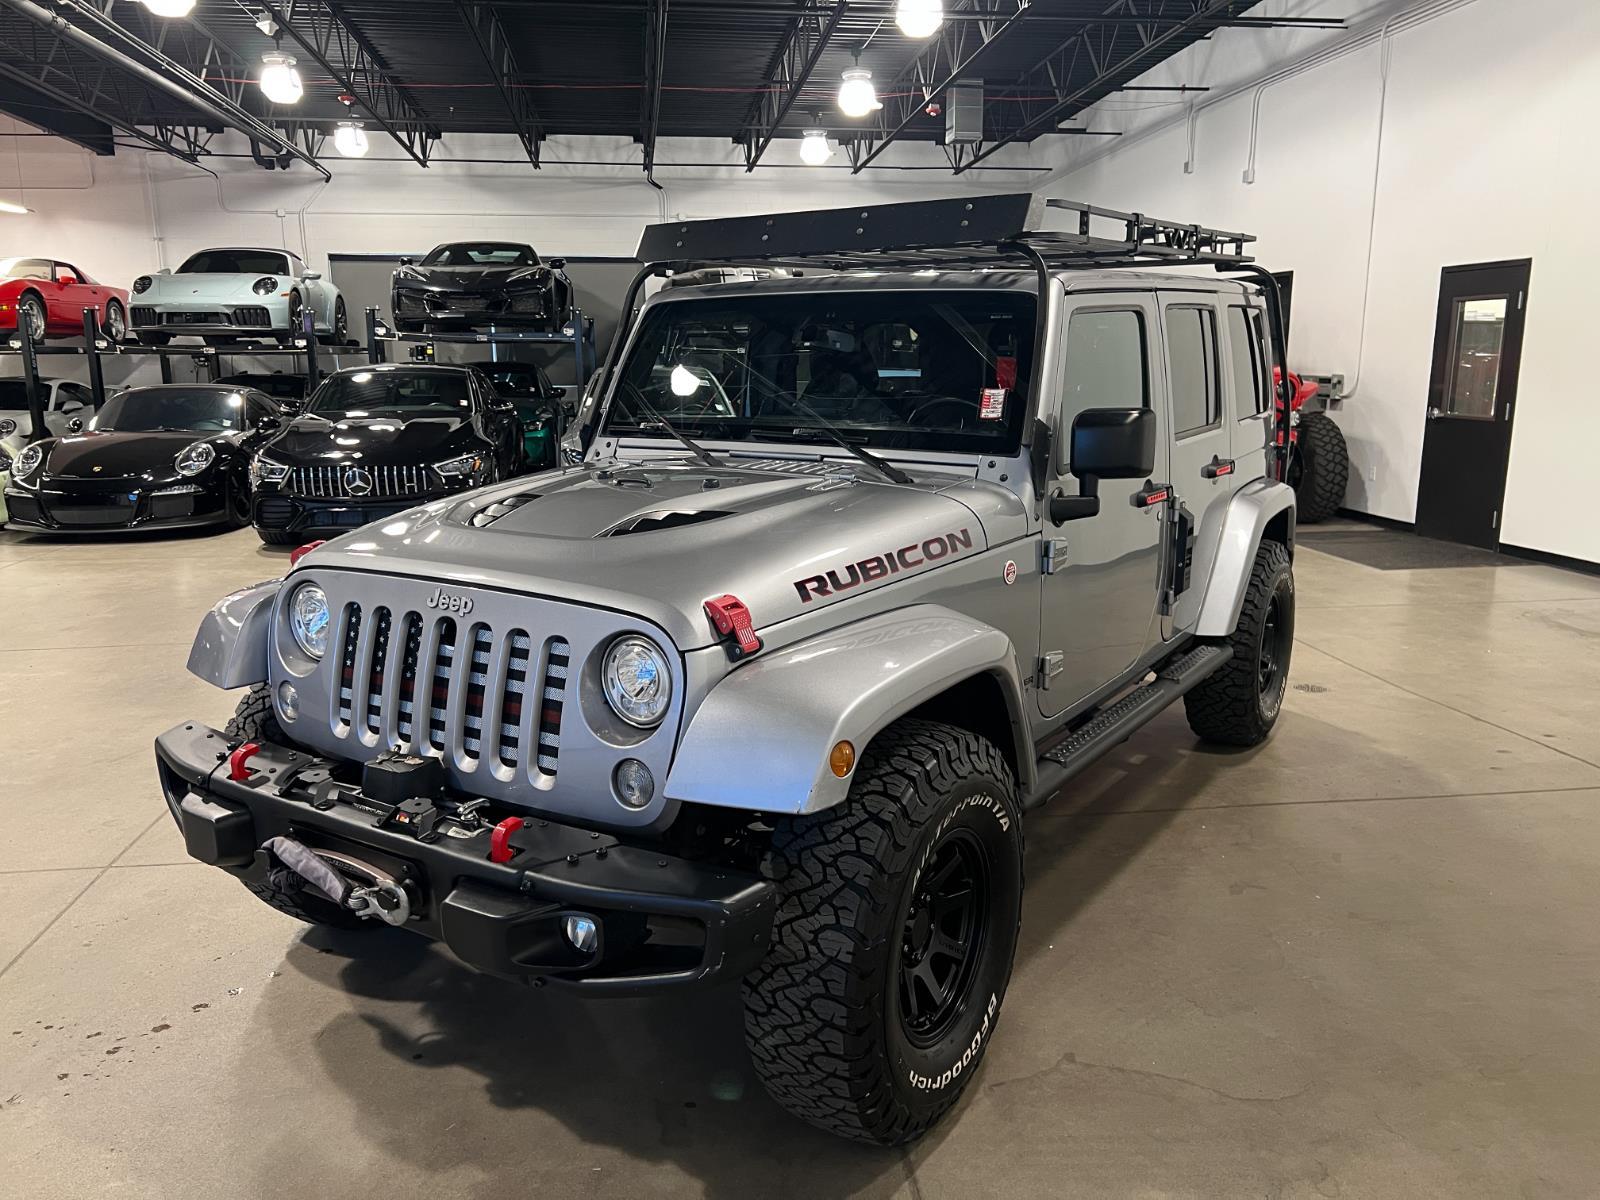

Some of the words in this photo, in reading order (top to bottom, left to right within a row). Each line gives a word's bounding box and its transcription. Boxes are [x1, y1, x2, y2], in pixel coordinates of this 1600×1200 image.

[793, 528, 973, 604] RUBICON
[426, 587, 474, 617] Jeep
[992, 800, 1010, 832] T/A
[909, 992, 997, 1093] BFGoodrich
